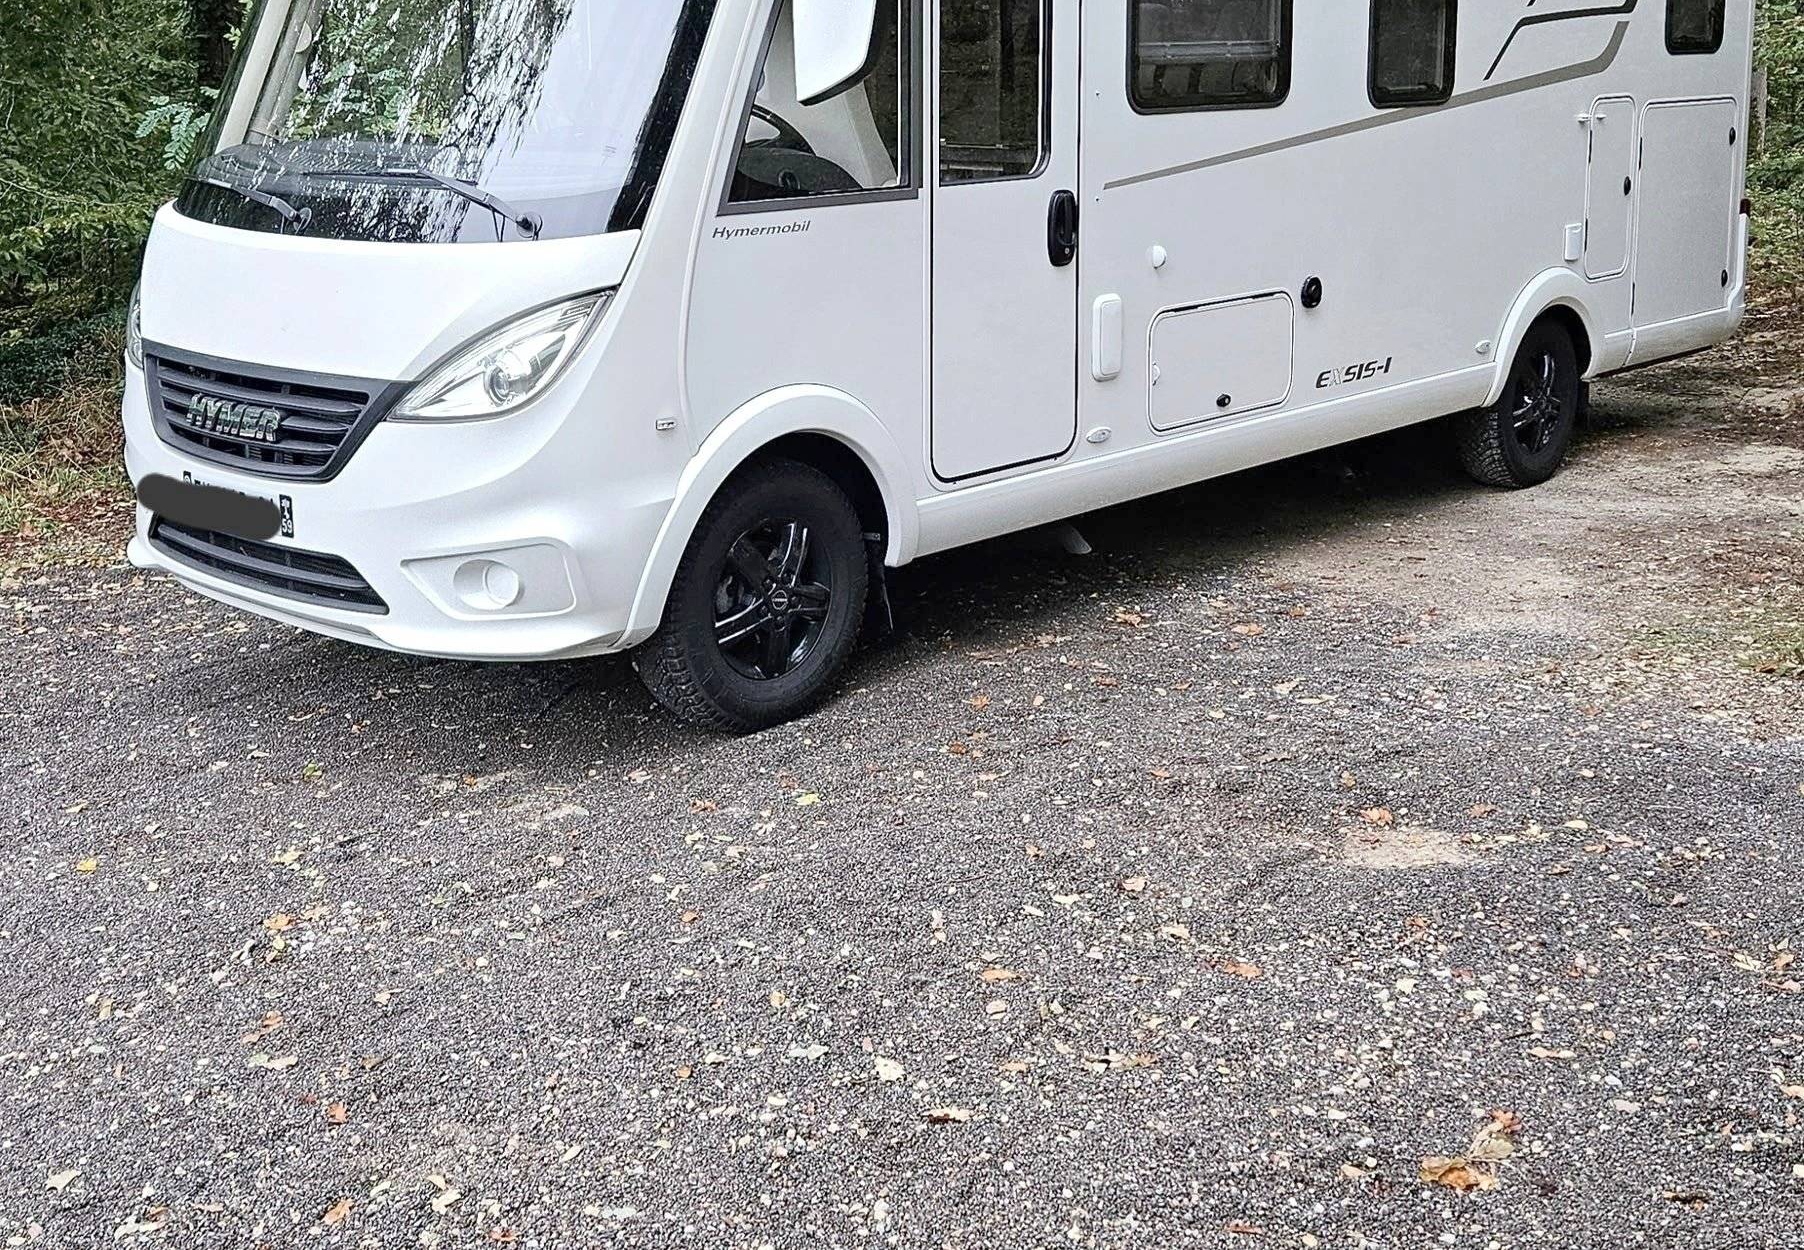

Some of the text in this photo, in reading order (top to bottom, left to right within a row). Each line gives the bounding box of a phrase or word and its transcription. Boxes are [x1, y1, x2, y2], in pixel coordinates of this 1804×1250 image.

[712, 220, 811, 240] Hymermobil
[1315, 356, 1392, 389] EXSIS-I
[186, 393, 280, 441] HYMER
[282, 518, 293, 533] 59
